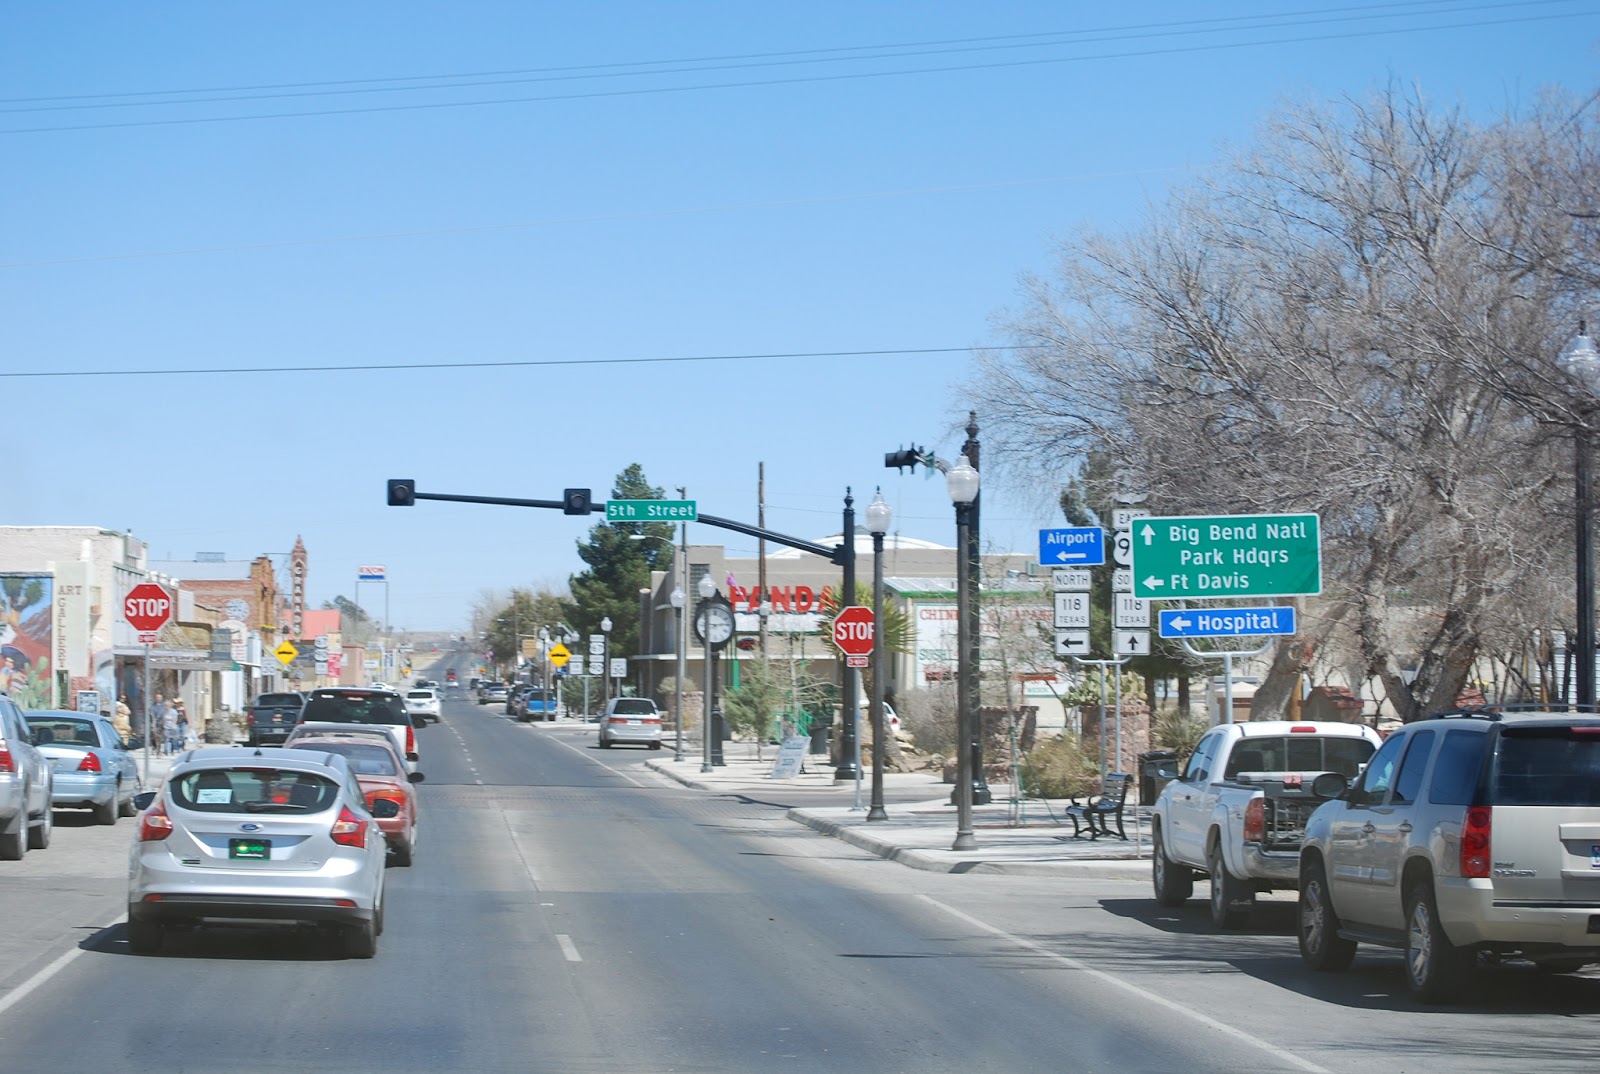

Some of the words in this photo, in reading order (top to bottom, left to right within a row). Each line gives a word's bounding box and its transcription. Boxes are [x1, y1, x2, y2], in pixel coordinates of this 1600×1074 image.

[610, 504, 636, 516] 5th
[647, 505, 694, 516] Street
[1046, 532, 1095, 546] Airport
[1169, 525, 1200, 545] Big
[1209, 523, 1257, 541] Bend
[1266, 522, 1307, 539] Natl
[1118, 538, 1130, 556] 9
[1181, 548, 1224, 565] Park
[1233, 547, 1289, 567] Hdqrs
[1056, 574, 1088, 586] NORTH
[1171, 574, 1189, 590] Ft
[1198, 572, 1250, 589] Davis
[58, 585, 82, 595] ART
[729, 585, 836, 613] PANDA
[1063, 599, 1082, 610] 118
[1123, 600, 1143, 610] 118
[126, 598, 169, 617] STOP
[1059, 616, 1085, 624] TEXAS
[1120, 616, 1147, 624] TEXAS
[1198, 612, 1279, 633] Hospital
[57, 597, 66, 668] GALLERY
[836, 622, 874, 640] STOP
[613, 667, 625, 675] 30
